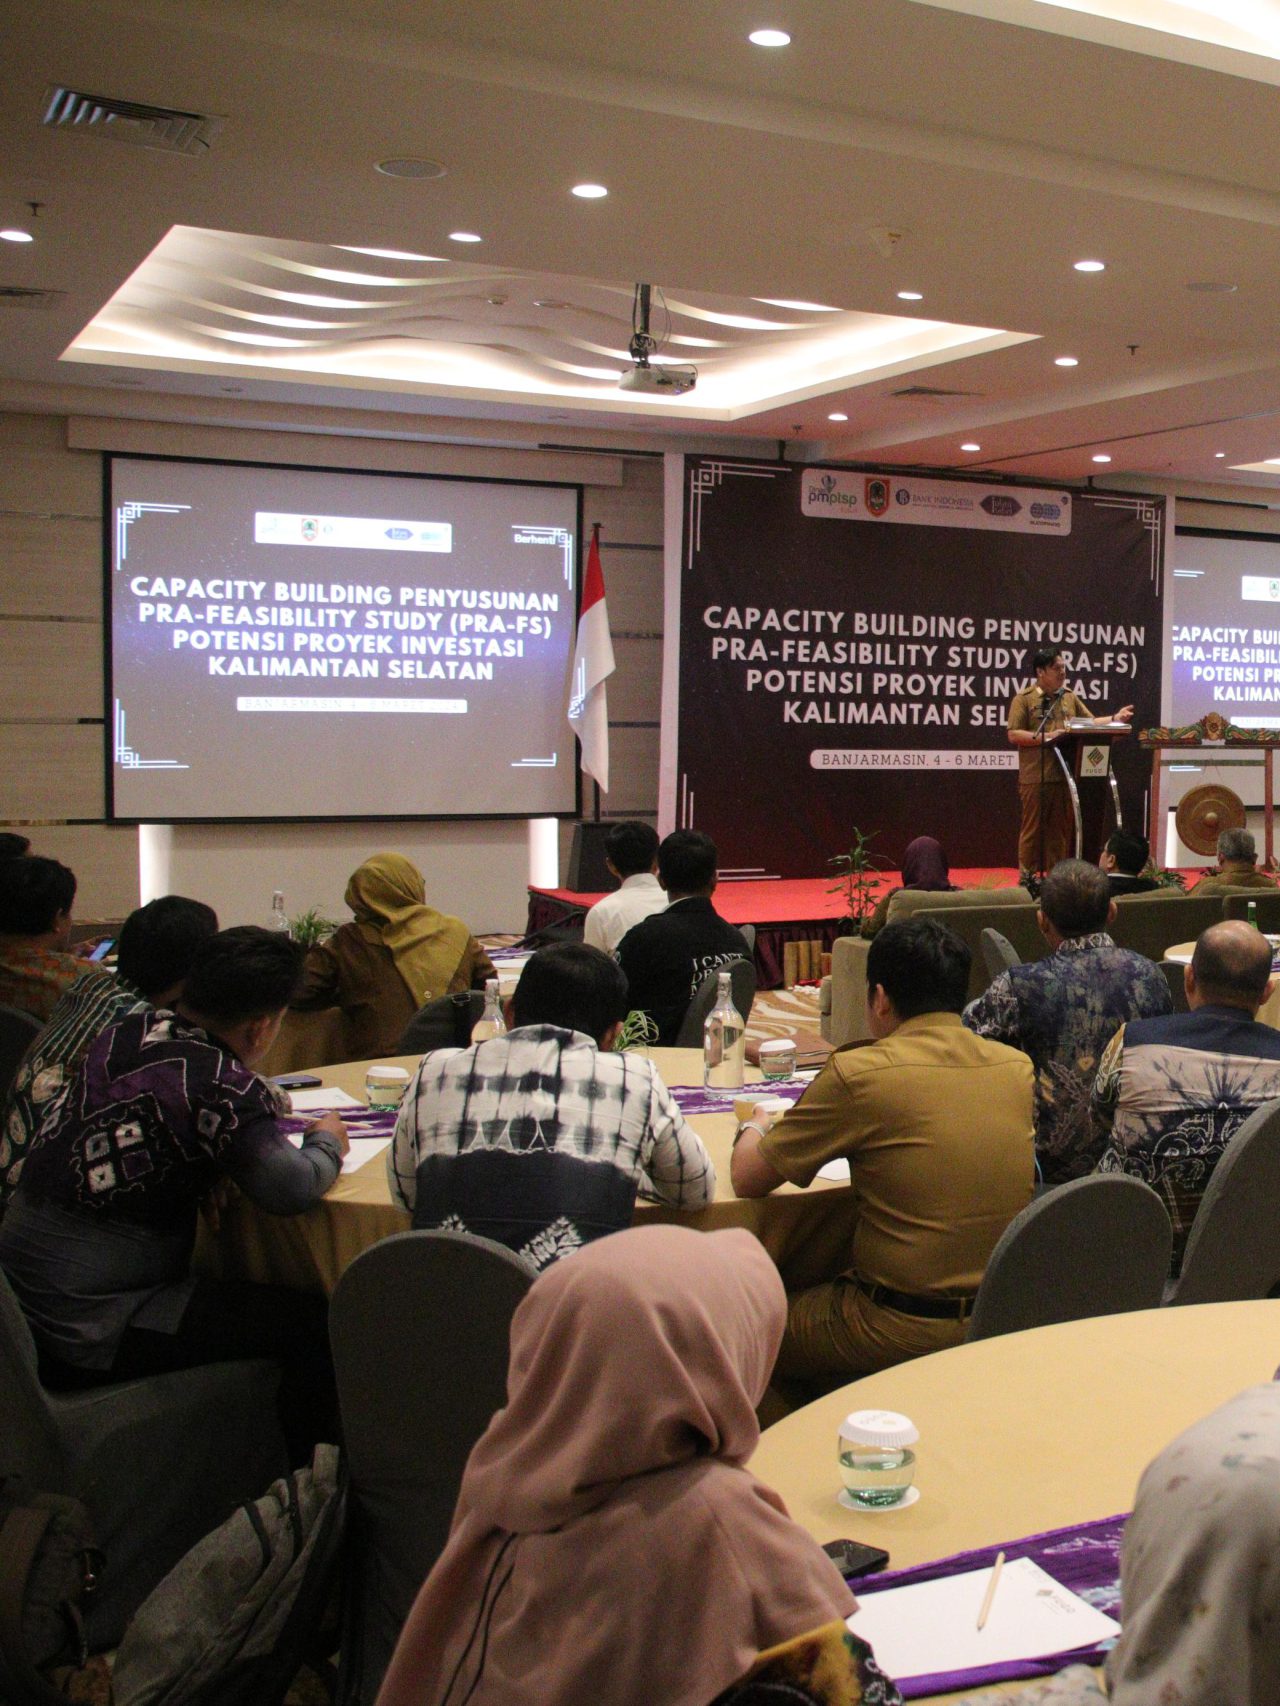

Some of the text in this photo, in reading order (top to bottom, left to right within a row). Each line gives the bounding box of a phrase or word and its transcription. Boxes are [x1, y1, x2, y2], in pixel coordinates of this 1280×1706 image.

[130, 576, 558, 612] CAPACITY BUILDING PENYUSUNAN
[138, 602, 551, 639] PRA-FEASIBILITY STUDY (PRA-FS)
[703, 606, 1145, 647] CAPACITY BUILDING PENYUSUNAN
[173, 629, 524, 657] POTENSI PROYEK INVESTASI
[712, 637, 938, 666] PRA-FEASIBILITY
[947, 646, 1027, 669] STUDY
[208, 656, 493, 680] KALIMANTAN SELATAN
[1192, 666, 1259, 682] POTENSI
[746, 669, 862, 694] POTENSI
[873, 673, 976, 697] PROYEK
[783, 701, 960, 725] KALIMANTAN
[933, 754, 941, 766] 4
[955, 754, 963, 766] 6
[968, 755, 1015, 767] MARET
